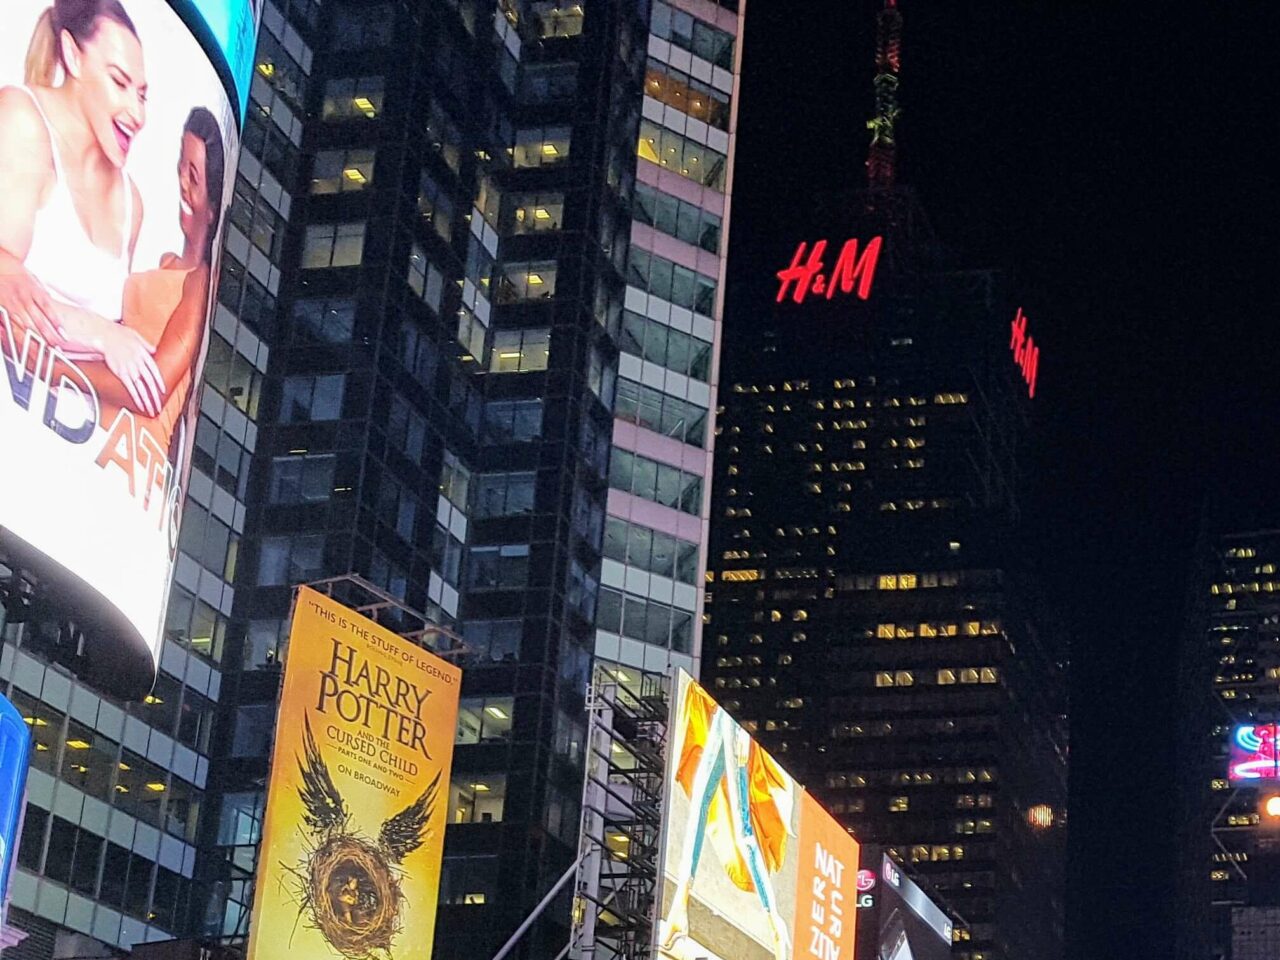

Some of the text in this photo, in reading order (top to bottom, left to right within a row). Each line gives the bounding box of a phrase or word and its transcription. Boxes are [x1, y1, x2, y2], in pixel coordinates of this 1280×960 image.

[776, 236, 883, 303] H&M
[338, 617, 347, 629] IS
[350, 622, 369, 641] THE
[370, 634, 399, 656] STUFF
[401, 651, 415, 665] OF
[328, 638, 432, 721] HARRY
[315, 670, 432, 760] POTTER
[357, 729, 390, 750] AND THE
[326, 725, 418, 776] CURSED CHILD
[337, 746, 404, 781] PARTS ONE AND TWO
[337, 764, 401, 798] ON BROADWAY
